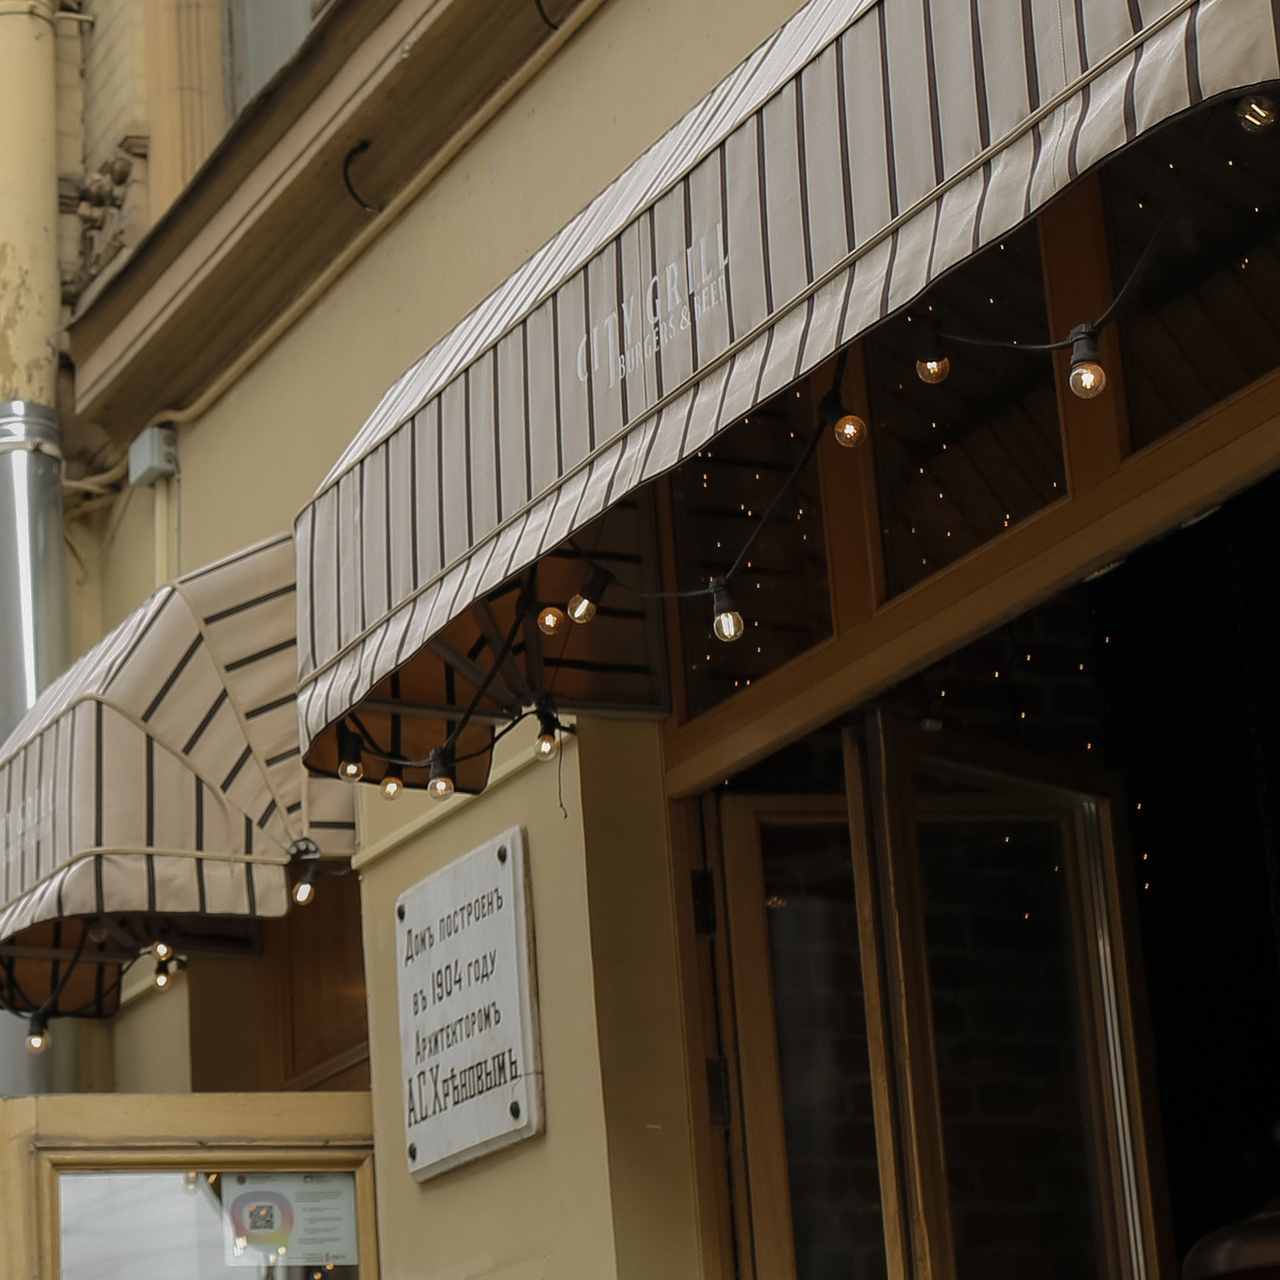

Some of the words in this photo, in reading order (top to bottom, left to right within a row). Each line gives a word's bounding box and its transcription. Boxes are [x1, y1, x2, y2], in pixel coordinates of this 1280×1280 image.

[576, 295, 634, 389] CITY
[646, 221, 729, 324] GRILL
[619, 318, 676, 381] BURGERS
[693, 274, 726, 321] BEER
[431, 959, 462, 1006] 1904
